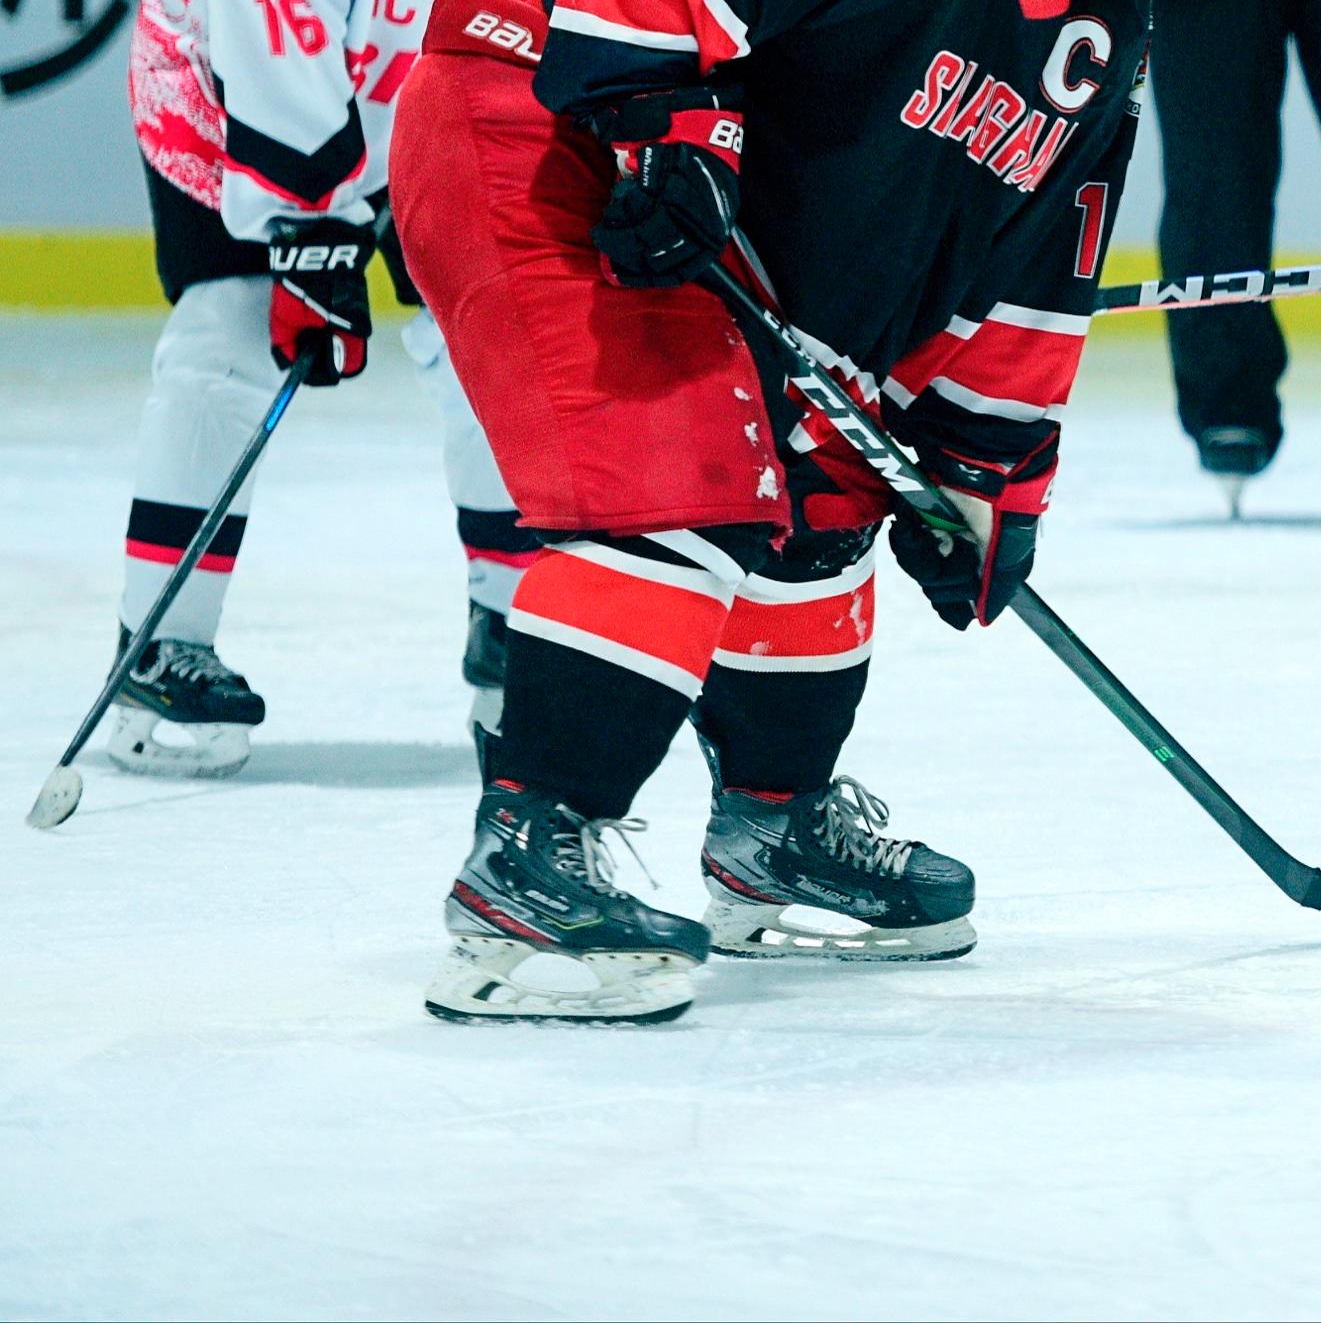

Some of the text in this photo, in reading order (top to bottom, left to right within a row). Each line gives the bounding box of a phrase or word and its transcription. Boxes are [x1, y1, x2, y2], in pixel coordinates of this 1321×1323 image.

[1038, 14, 1115, 114] C
[268, 244, 360, 272] UER
[788, 372, 926, 493] CCM
